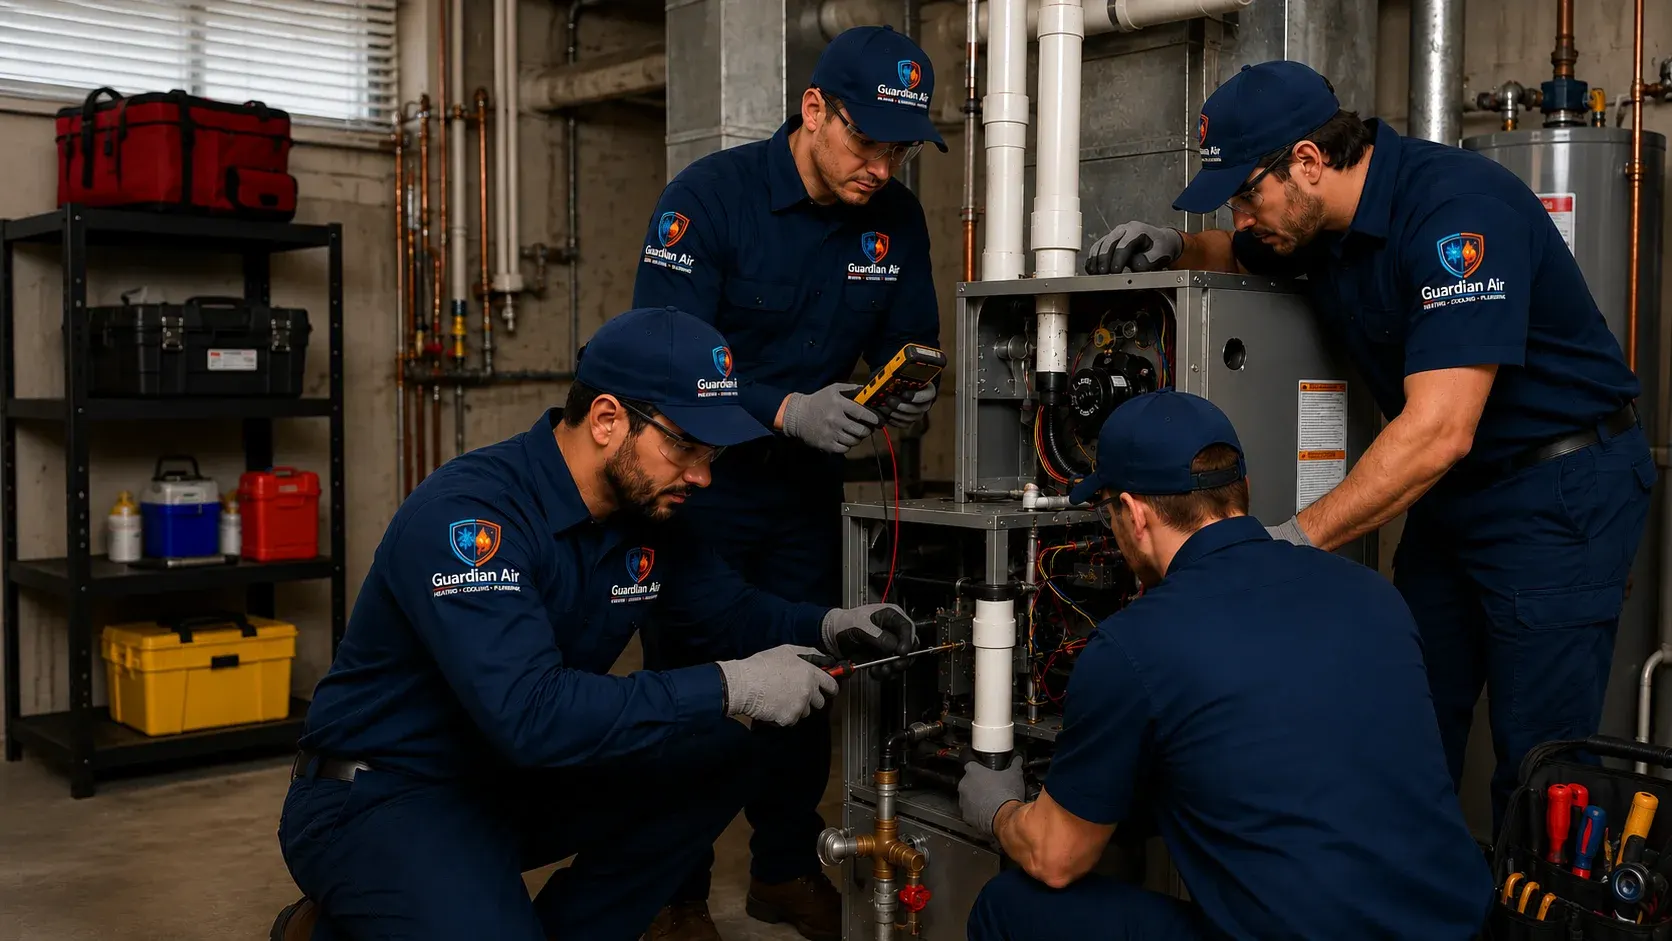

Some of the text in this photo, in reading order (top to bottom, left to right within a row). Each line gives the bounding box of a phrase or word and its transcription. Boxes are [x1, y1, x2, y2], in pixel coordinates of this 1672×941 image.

[877, 84, 918, 100] Guardian
[678, 253, 695, 266] Air
[848, 263, 900, 274] Guardian Air
[1421, 278, 1505, 300] Guardian Air
[432, 568, 520, 587] Guardian Air
[611, 583, 648, 596] Guardian
